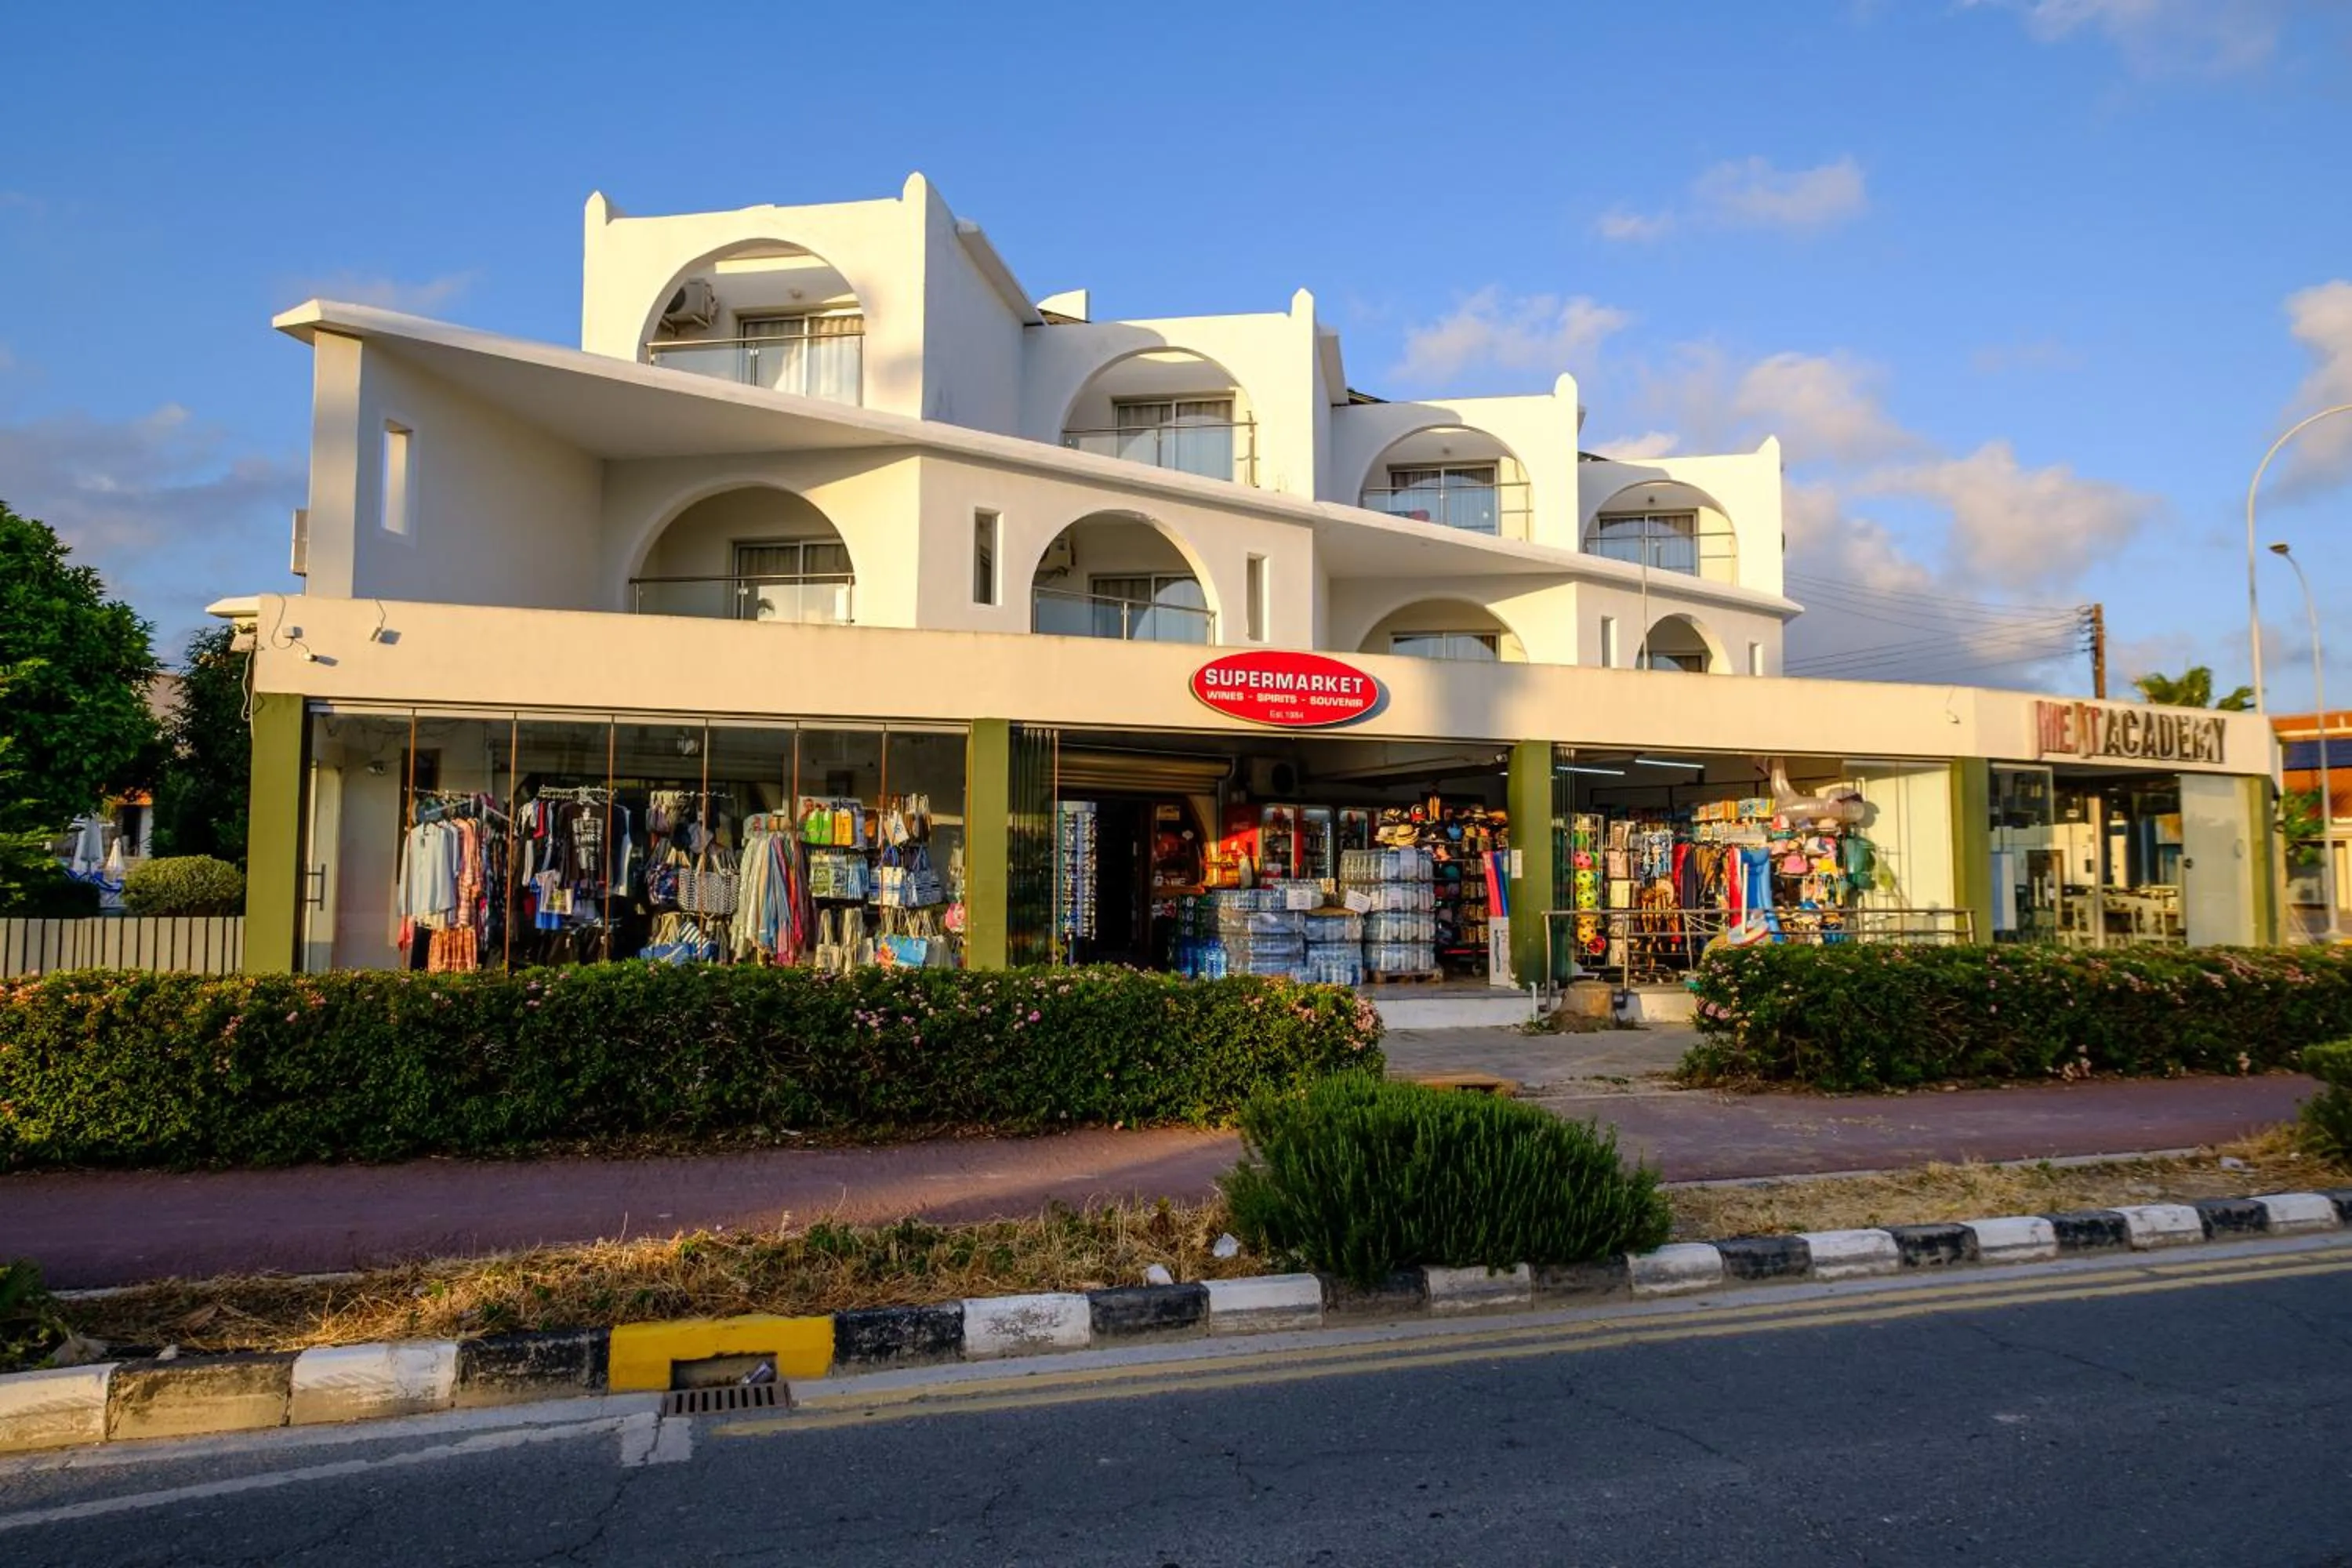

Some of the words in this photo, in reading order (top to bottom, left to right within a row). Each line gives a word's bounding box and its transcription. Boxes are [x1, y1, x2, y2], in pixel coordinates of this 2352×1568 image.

[1205, 668, 1363, 694] SUPERMARKET
[1207, 690, 1244, 702] WINES
[1257, 692, 1298, 704] SPIRITS
[1309, 695, 1364, 708] SOUVENIR
[2104, 708, 2226, 764] ACADEMY
